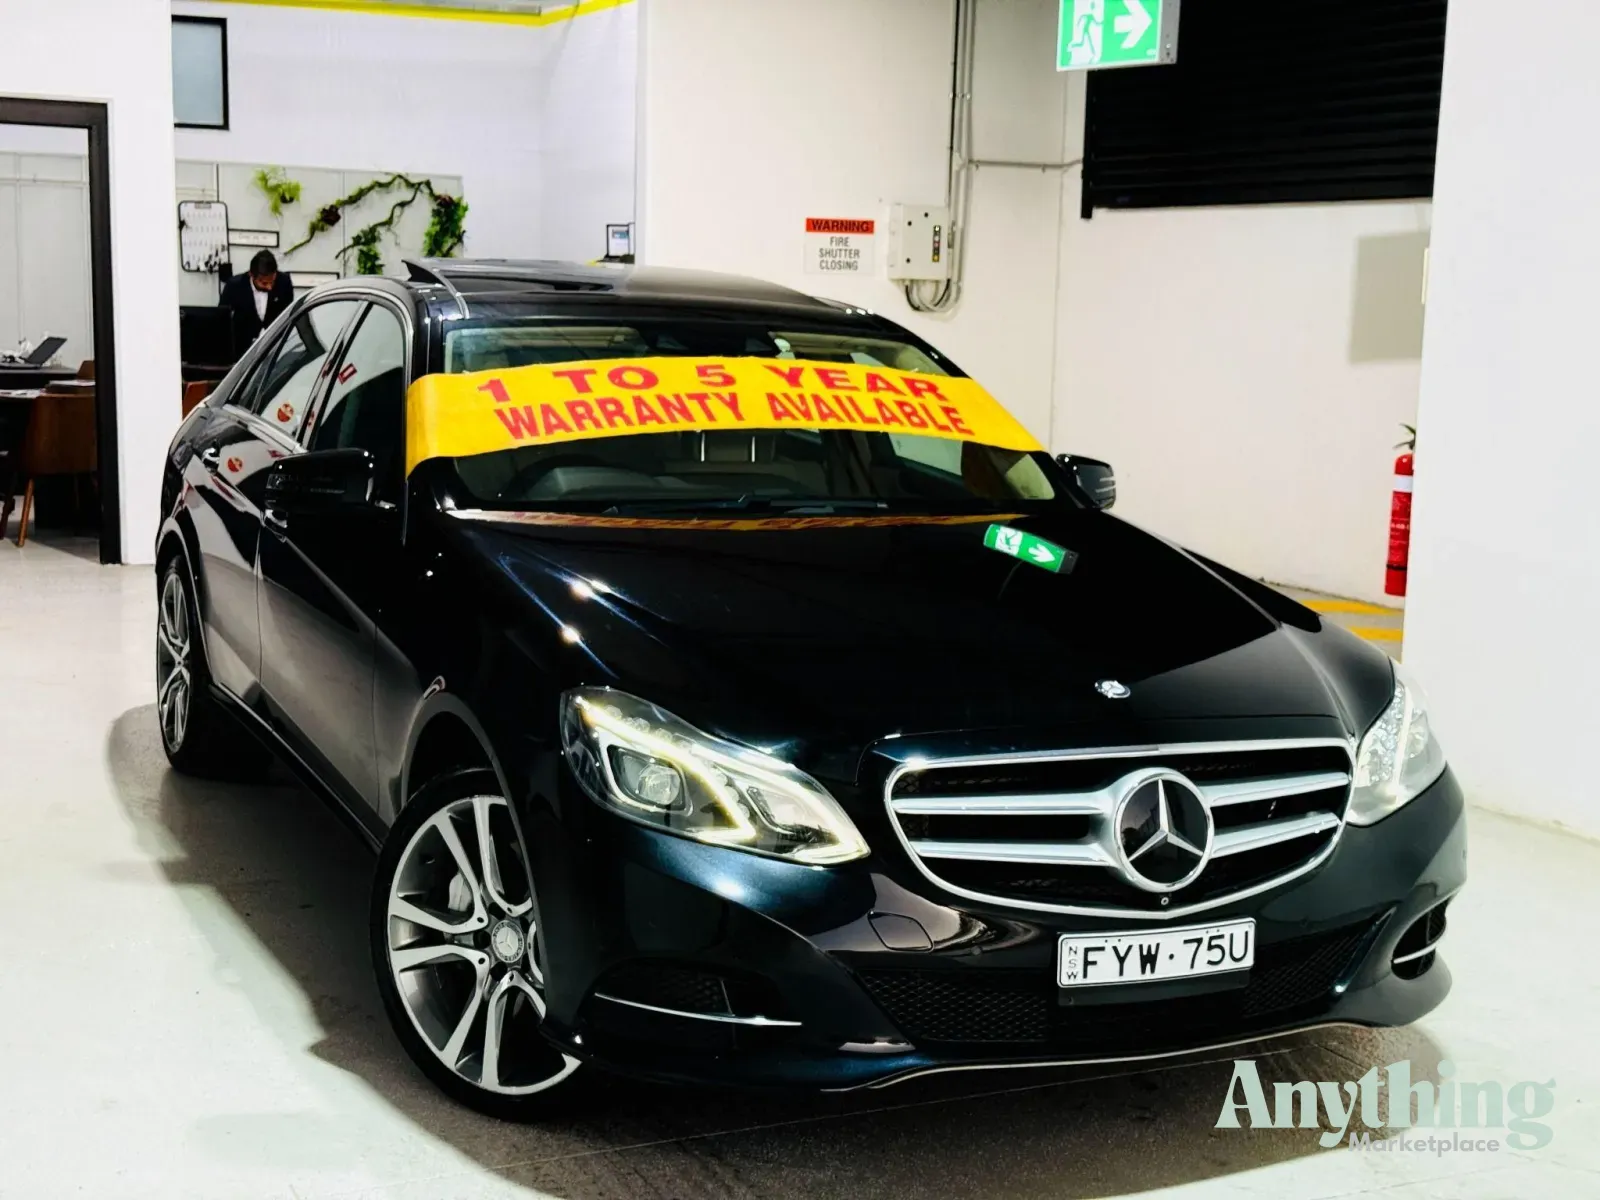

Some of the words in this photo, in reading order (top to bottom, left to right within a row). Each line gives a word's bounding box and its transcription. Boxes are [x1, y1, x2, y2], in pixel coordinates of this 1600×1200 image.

[812, 219, 869, 232] WARNING
[829, 236, 850, 247] FIRE
[818, 248, 860, 259] SHUTTER
[819, 260, 858, 271] CLOSING
[478, 378, 511, 402] 1
[552, 366, 659, 394] TO
[695, 364, 736, 387] 5
[762, 364, 948, 400] YEAR
[494, 392, 745, 440] WARRANTY
[765, 392, 975, 436] AVAILABLE
